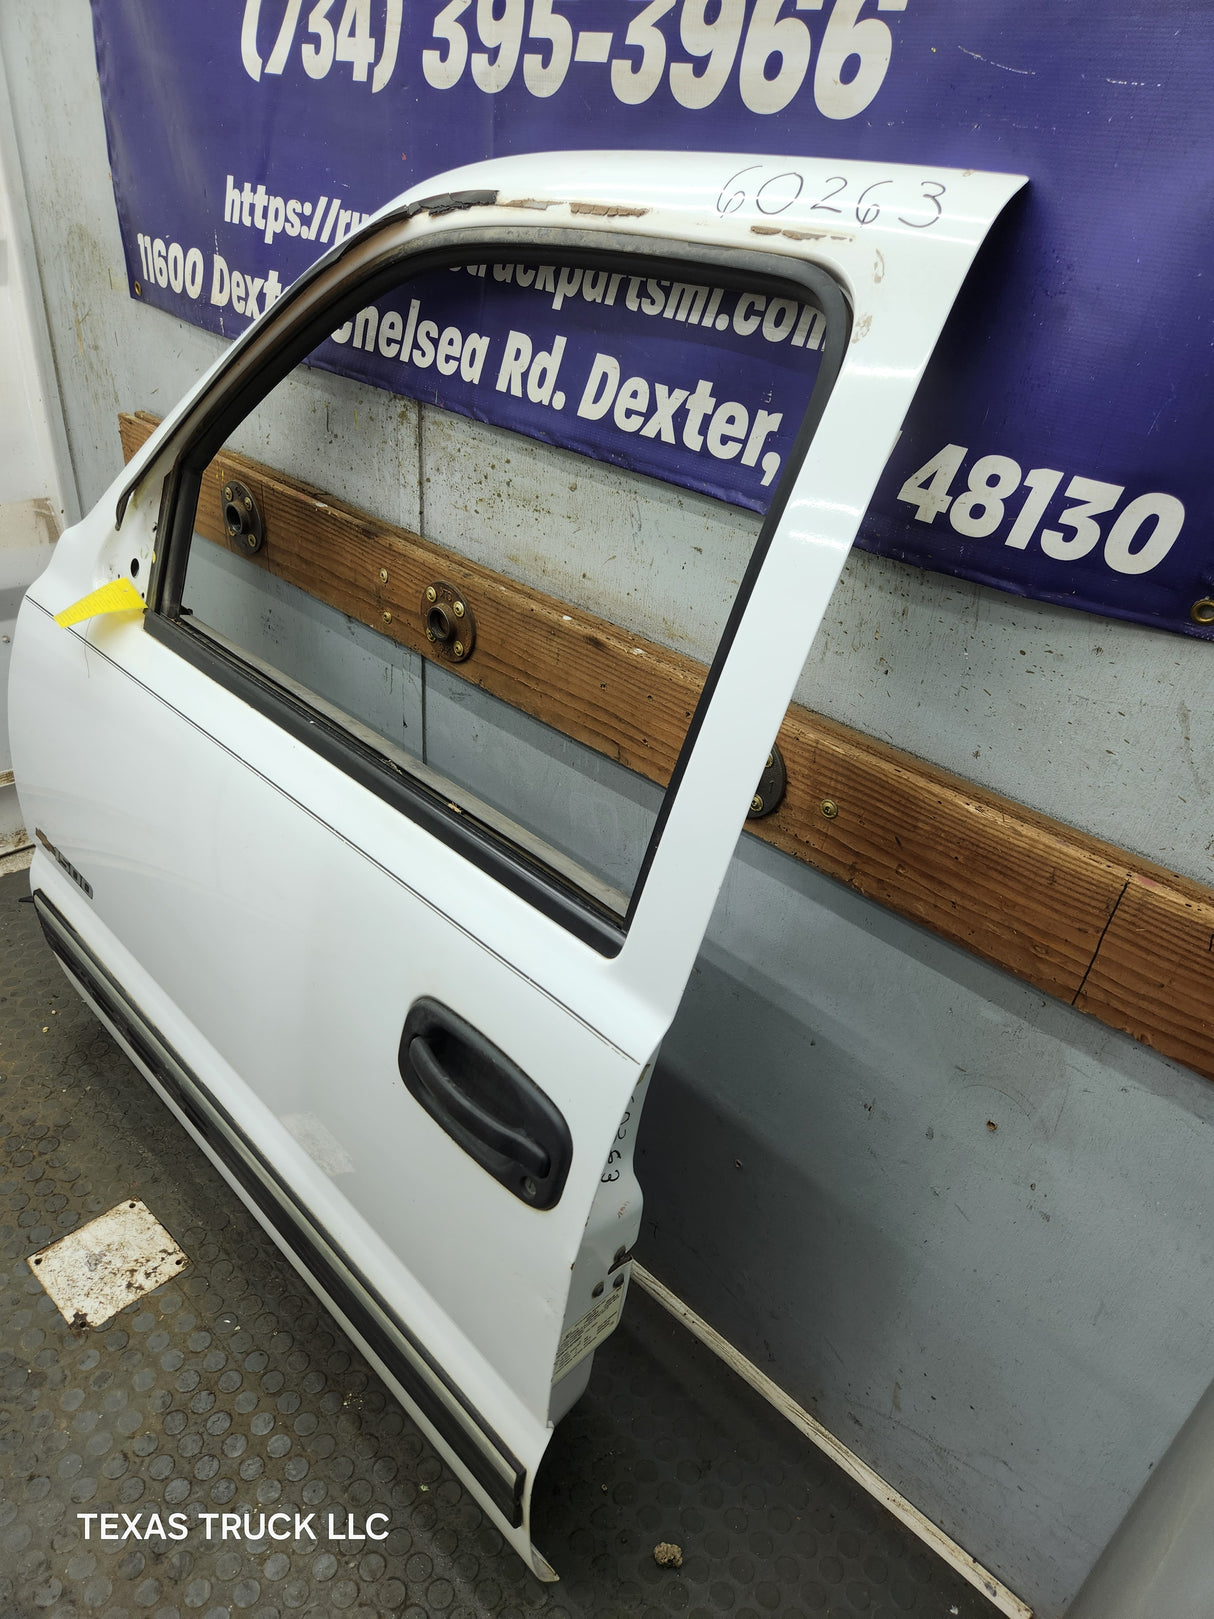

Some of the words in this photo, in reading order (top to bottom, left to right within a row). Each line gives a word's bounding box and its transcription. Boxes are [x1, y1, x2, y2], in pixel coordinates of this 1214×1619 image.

[422, 0, 907, 120] 395-3966
[716, 165, 946, 228] 60263
[137, 233, 204, 300] 11600
[210, 254, 290, 320] Dext
[496, 330, 566, 411] Rd.
[577, 352, 784, 487] Dexter,
[897, 444, 1186, 575] 48130
